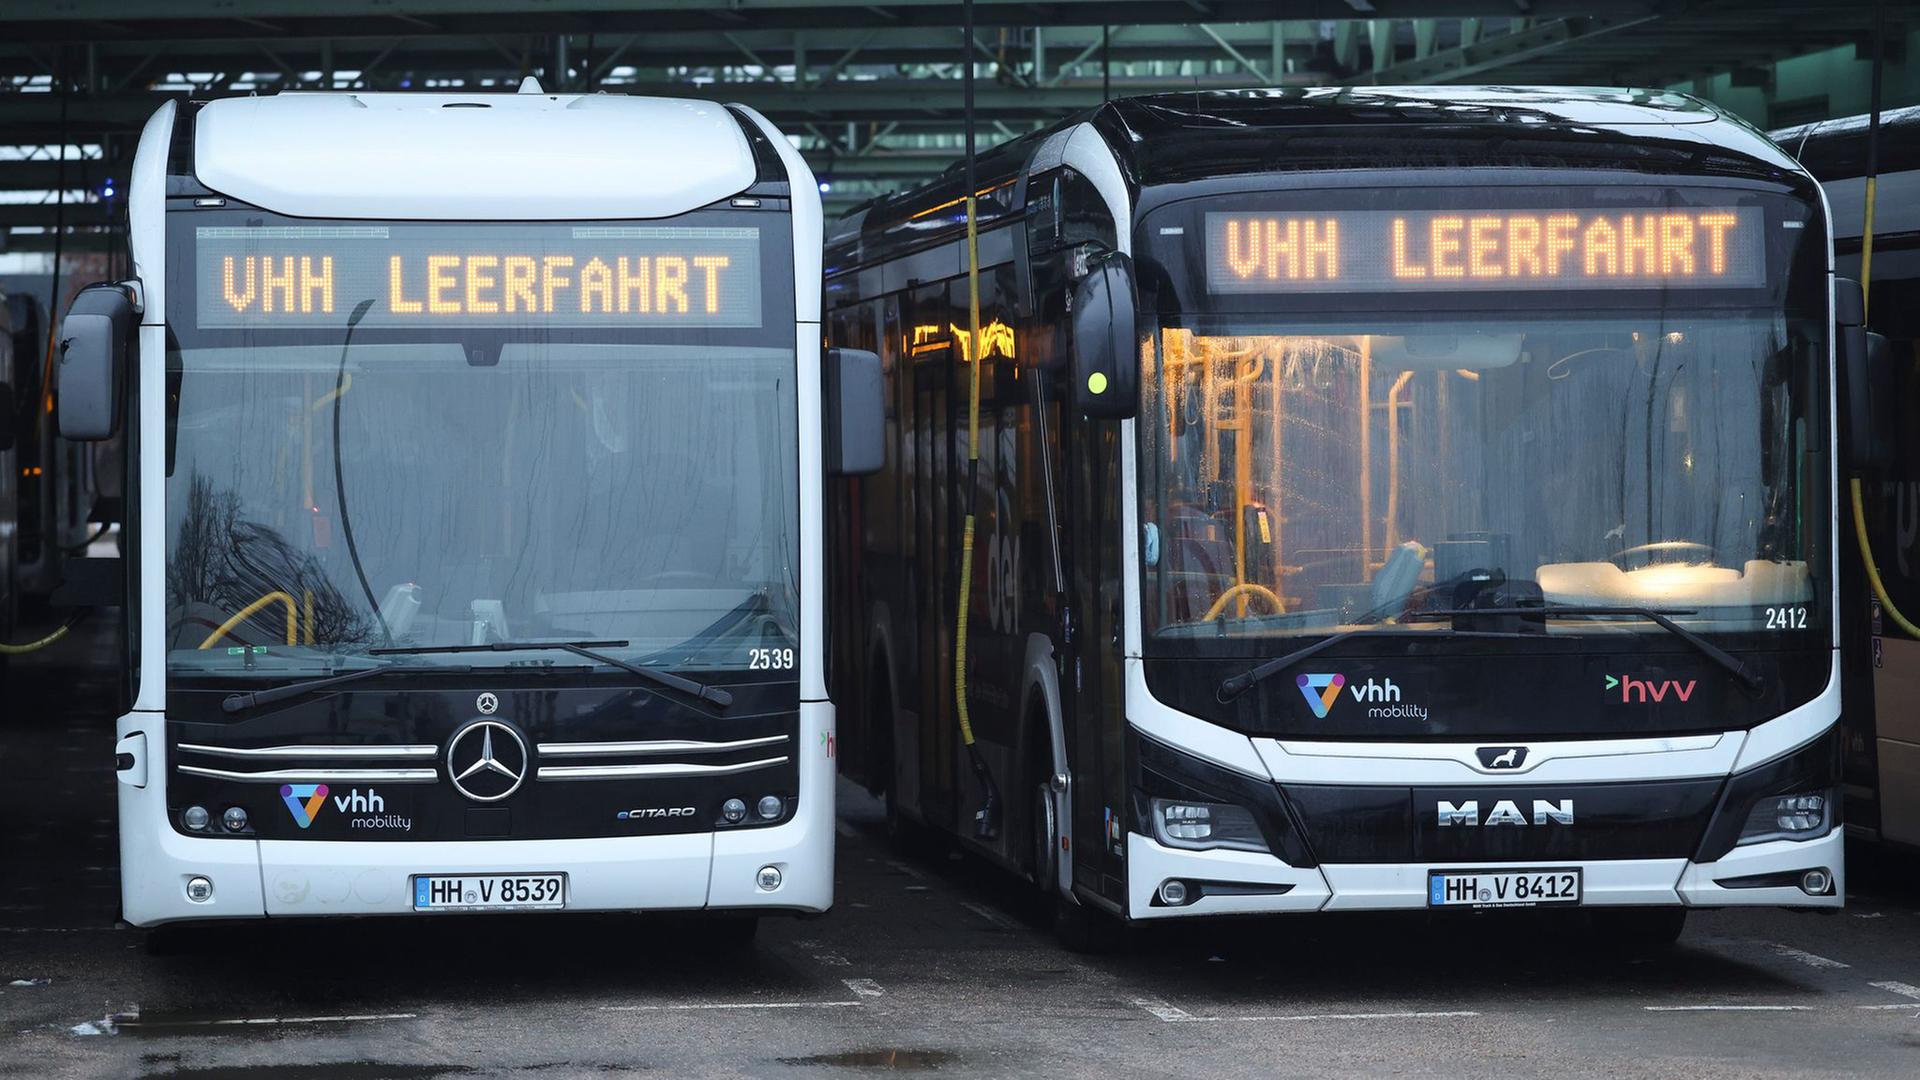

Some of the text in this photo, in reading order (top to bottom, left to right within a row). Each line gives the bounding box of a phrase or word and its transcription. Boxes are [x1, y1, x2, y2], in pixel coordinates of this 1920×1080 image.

[1227, 213, 1737, 279] VHH LEERFAHRT
[224, 255, 729, 314] VHH LEERFAHRT
[1766, 607, 1807, 629] 2412
[749, 648, 794, 669] 2539
[1350, 678, 1401, 702] vhh
[1368, 704, 1428, 721] mobility
[334, 788, 384, 813] vhh
[1437, 799, 1574, 826] MAN
[351, 815, 412, 832] mobility
[431, 880, 462, 903] HH
[479, 880, 494, 902] V
[500, 879, 560, 902] 8539
[1446, 878, 1477, 901] HH
[1494, 876, 1509, 899] V
[1516, 875, 1575, 899] 8412
